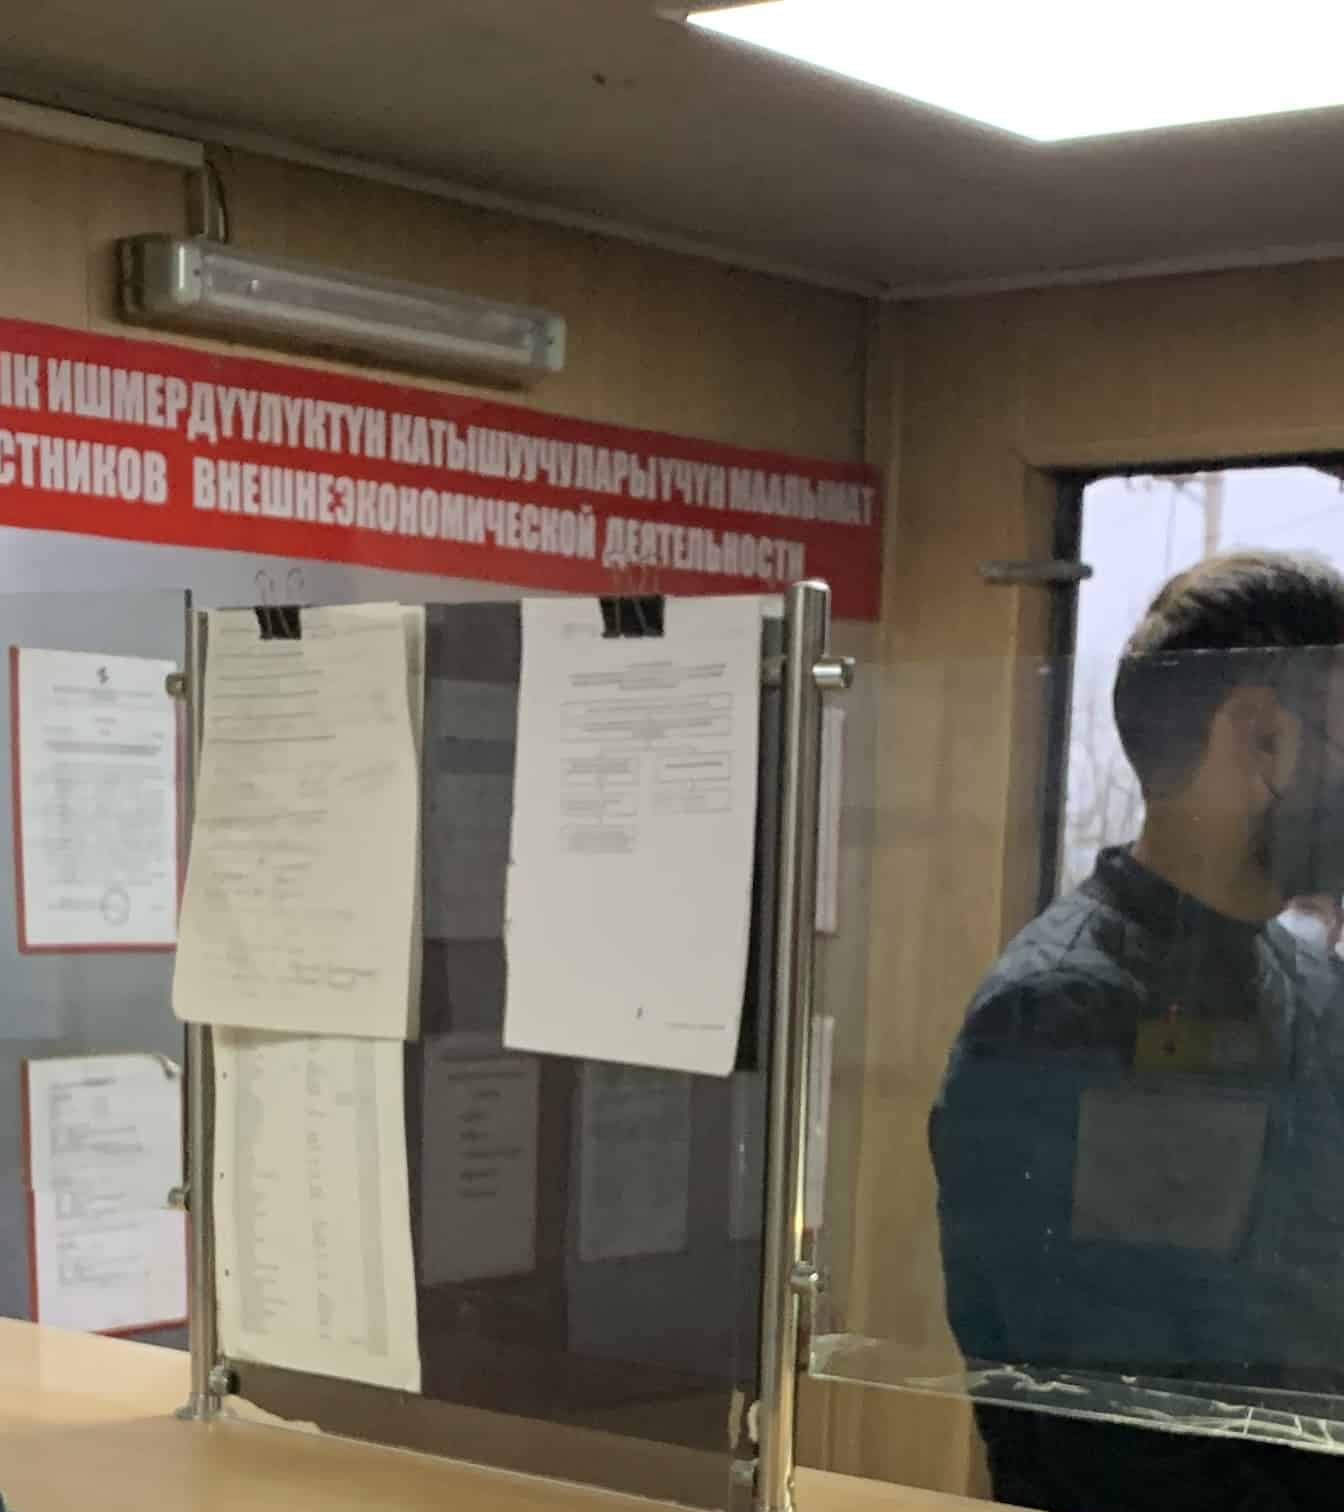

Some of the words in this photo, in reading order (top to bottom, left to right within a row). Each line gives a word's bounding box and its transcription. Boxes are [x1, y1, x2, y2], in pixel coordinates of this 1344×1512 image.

[390, 411, 656, 500] КАТЫШУУЧУЛАРЫ
[192, 456, 596, 560] ВНЕШНЕЭКОНОМИЧЕСКОЙ
[601, 515, 805, 582] ДЕЯТЕЛЬНОСТИ
